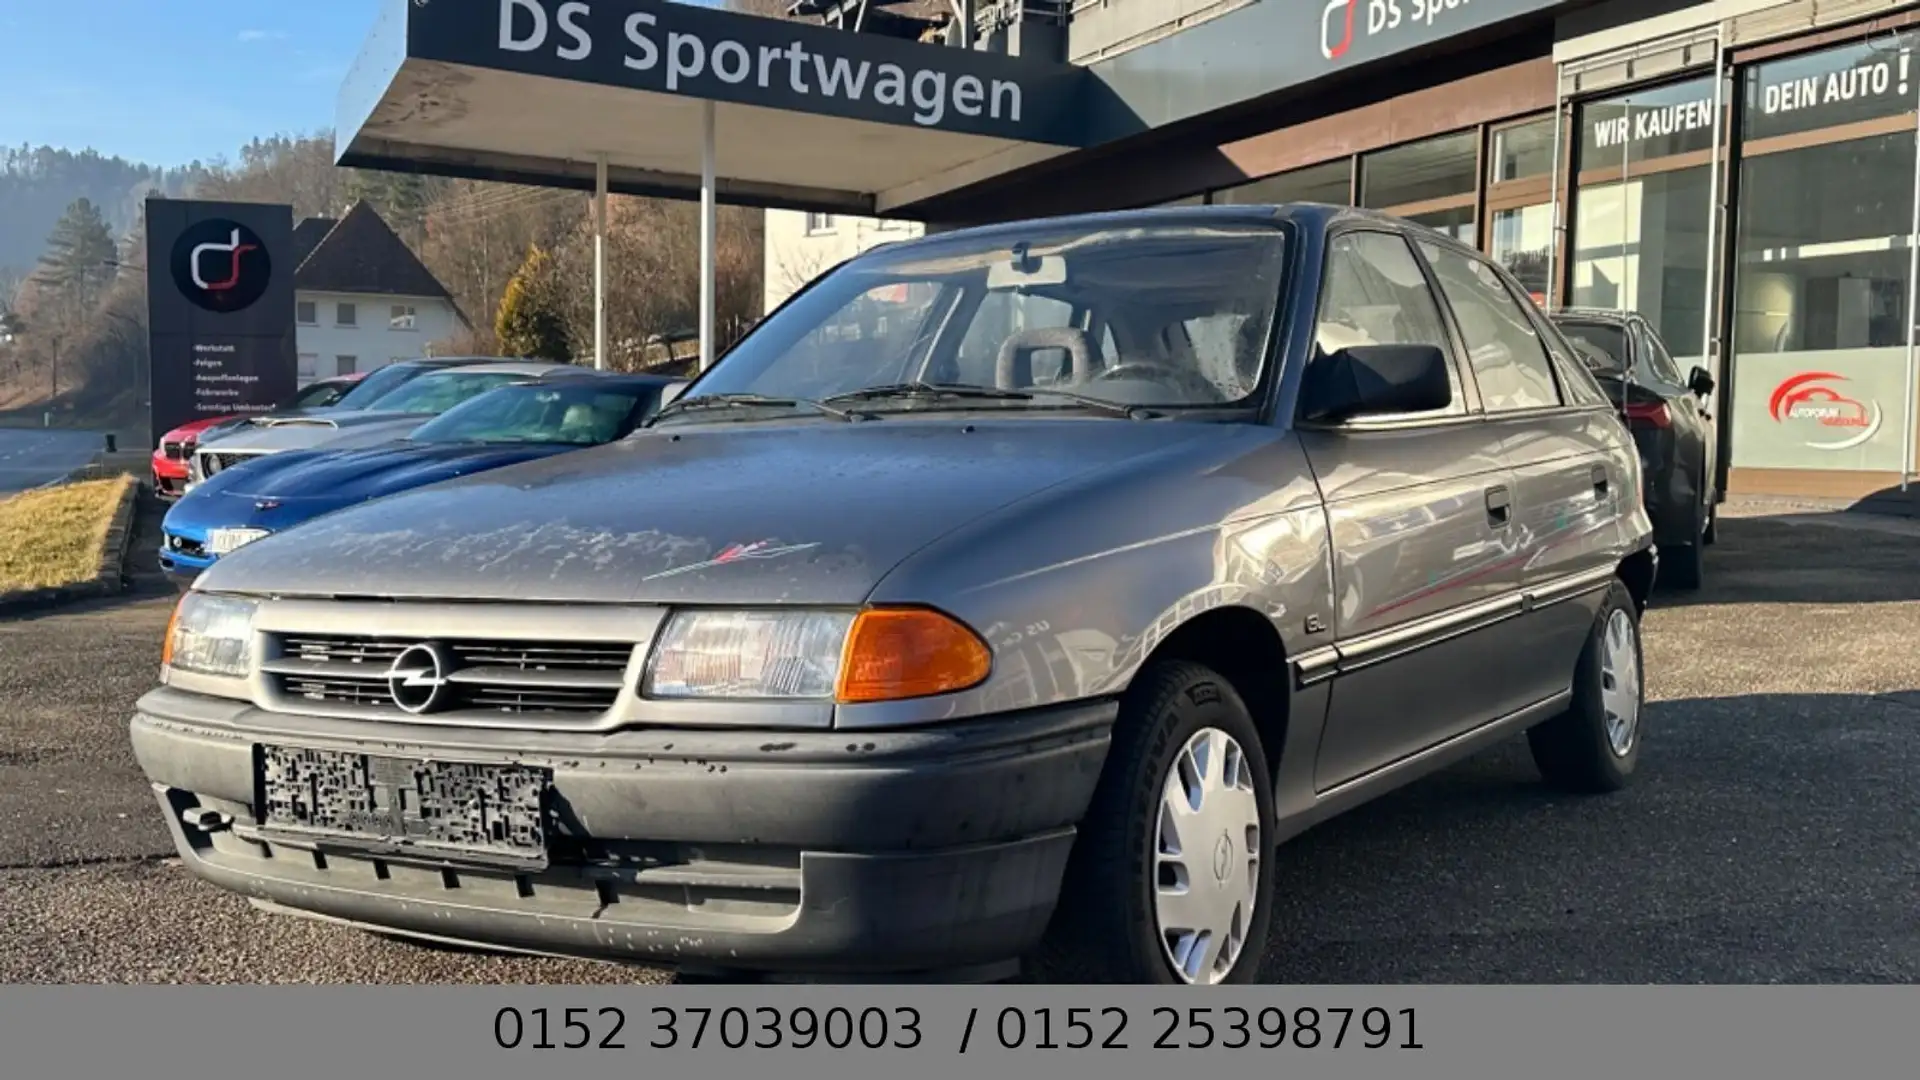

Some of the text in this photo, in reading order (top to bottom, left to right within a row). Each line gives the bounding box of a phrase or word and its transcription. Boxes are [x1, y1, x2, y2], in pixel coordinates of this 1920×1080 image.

[1368, 0, 1401, 36] DS
[498, 0, 1021, 125] DS Sportwagen
[1765, 47, 1911, 114] DEIN AUTO !
[1594, 98, 1712, 148] WIR KAUFEN
